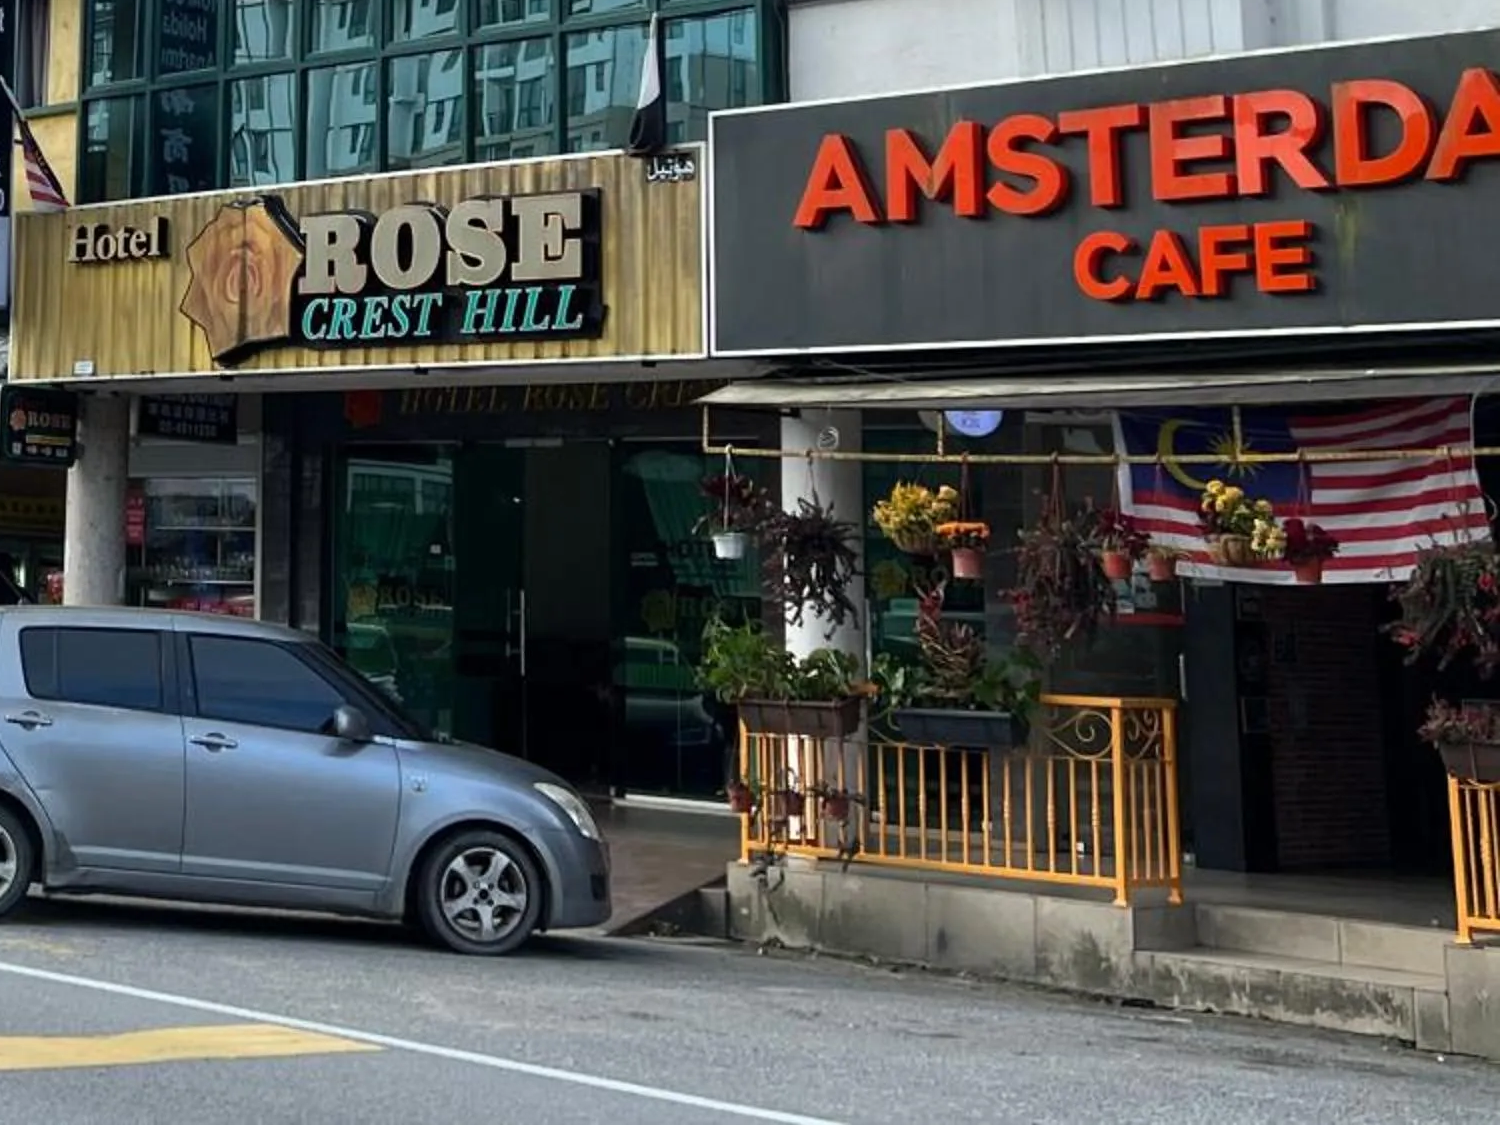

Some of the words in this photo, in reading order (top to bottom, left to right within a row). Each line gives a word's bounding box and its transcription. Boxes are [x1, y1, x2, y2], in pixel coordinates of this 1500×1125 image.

[68, 216, 161, 263] Hotel
[298, 191, 583, 296] ROSE
[1072, 219, 1316, 302] CAFE
[302, 291, 442, 341] CREST
[460, 284, 584, 334] HILL
